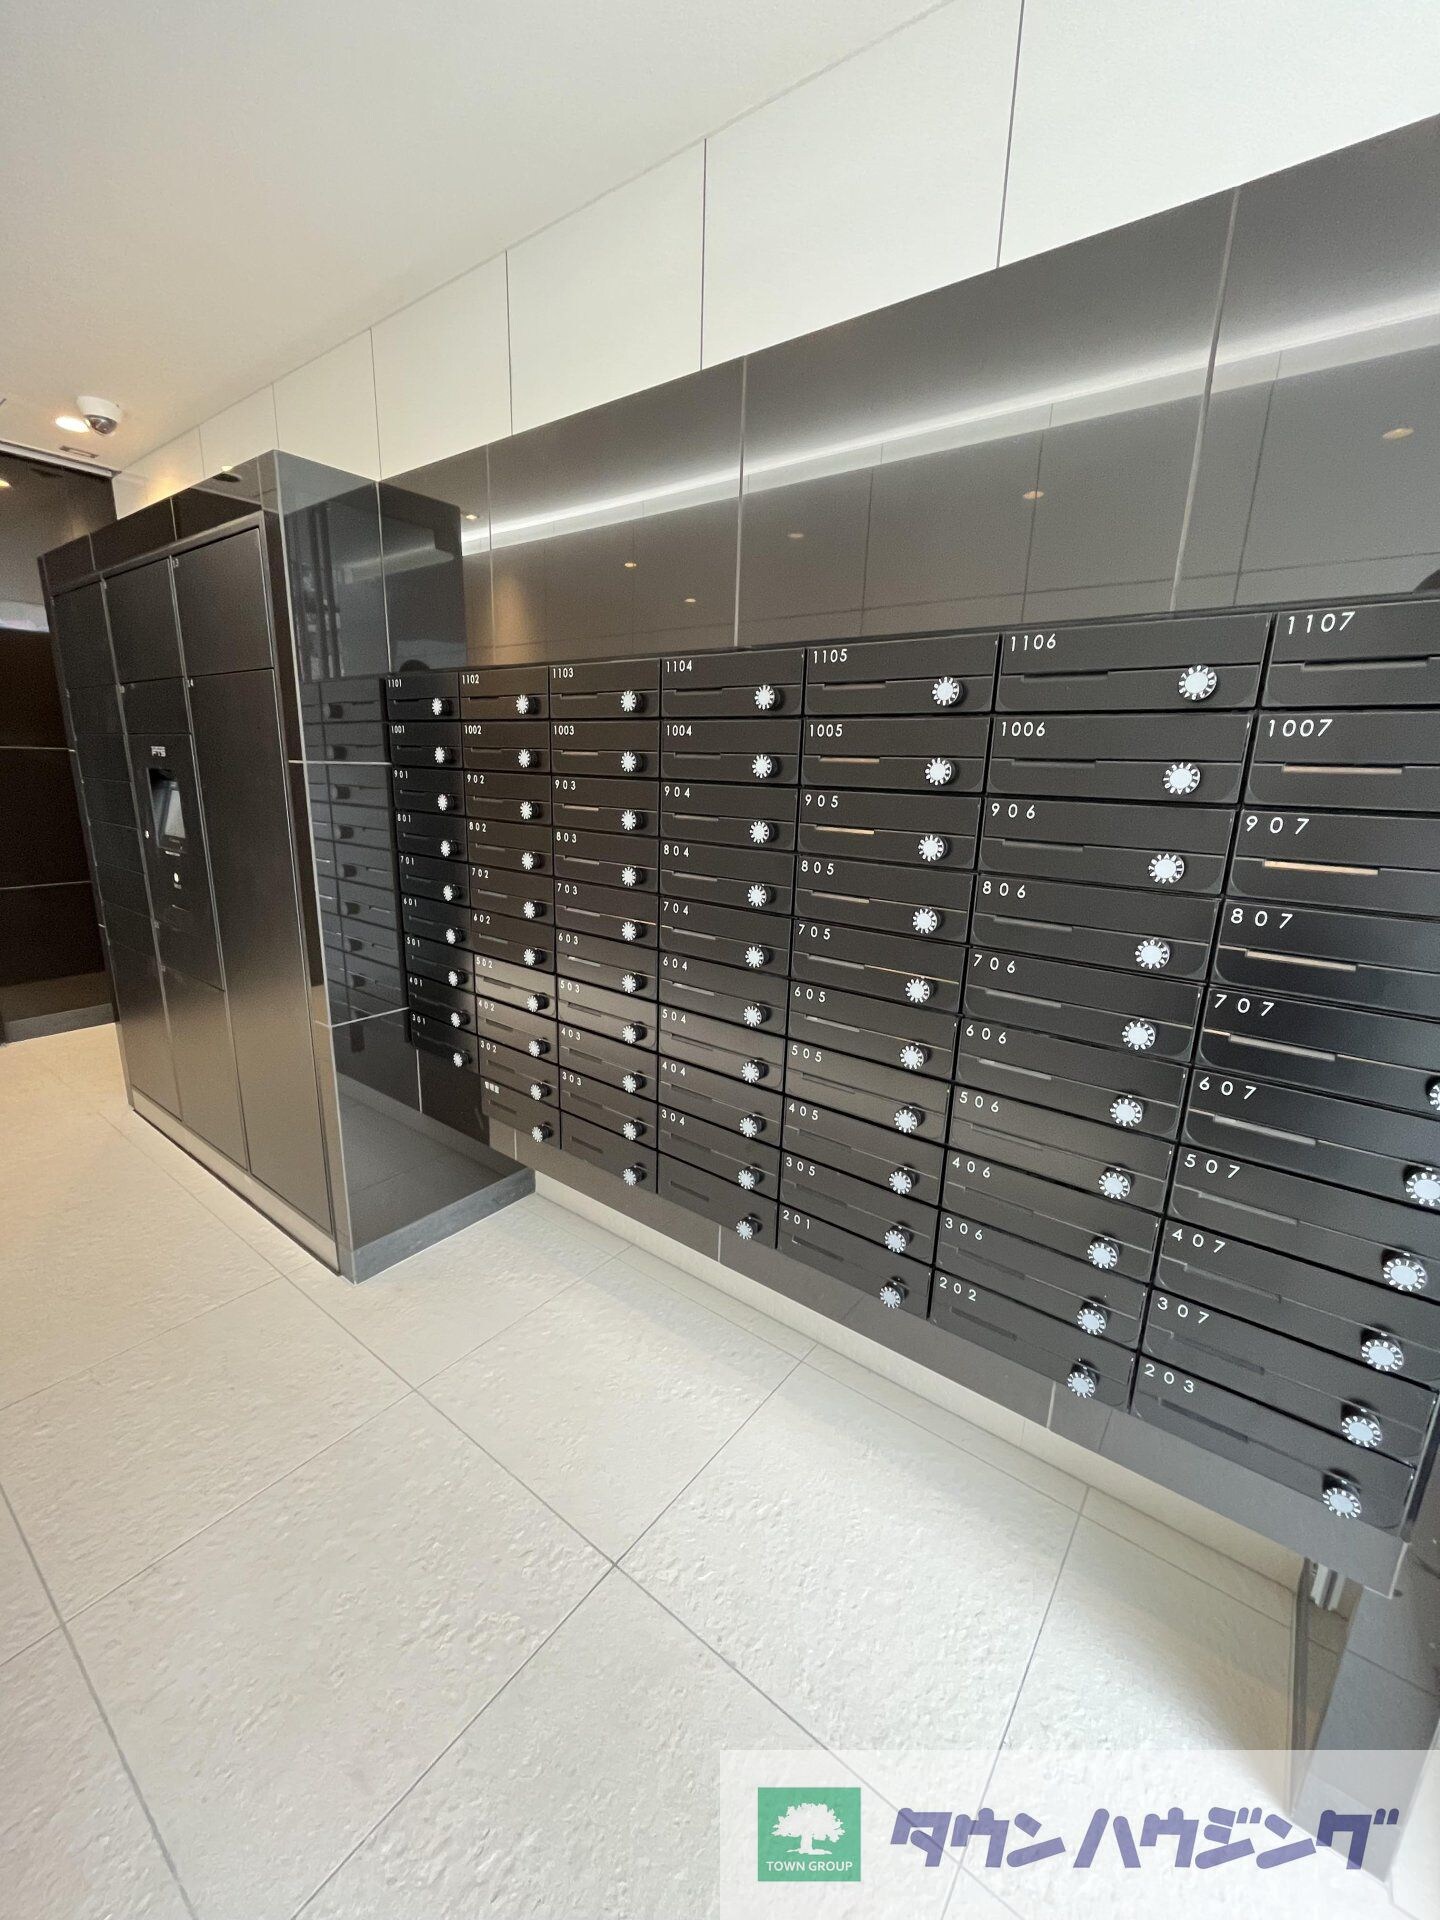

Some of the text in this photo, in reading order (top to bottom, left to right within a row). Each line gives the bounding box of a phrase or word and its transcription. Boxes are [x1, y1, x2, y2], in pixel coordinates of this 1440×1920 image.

[1289, 611, 1355, 634] 1107
[1012, 634, 1055, 651] 1106
[814, 649, 847, 663] 1105
[553, 668, 573, 678] 1103
[667, 660, 692, 672] 1104
[463, 674, 479, 684] 1102
[465, 725, 481, 734] 1002
[554, 725, 574, 735] 1003
[667, 725, 691, 736] 1004
[810, 724, 842, 737] 1005
[1003, 722, 1045, 736] 1006
[1270, 719, 1332, 737] 1007
[467, 774, 484, 784] 902
[555, 780, 575, 790] 903
[665, 786, 690, 798] 904
[806, 794, 838, 807] 905
[992, 803, 1035, 819] 906
[469, 822, 486, 832] 802
[1247, 816, 1309, 834] 907
[557, 832, 576, 843] 803
[664, 844, 689, 857] 804
[472, 868, 488, 878] 702
[802, 860, 833, 875] 805
[558, 883, 577, 895] 703
[983, 881, 1025, 898] 806
[664, 902, 688, 915] 704
[474, 914, 490, 924] 602
[1231, 908, 1293, 928] 807
[559, 933, 578, 944] 603
[799, 924, 830, 940] 705
[476, 957, 492, 968] 502
[663, 957, 687, 970] 604
[974, 954, 1015, 973] 706
[561, 980, 579, 993] 503
[795, 987, 825, 1002] 605
[479, 1000, 494, 1011] 402
[1215, 994, 1274, 1016] 707
[662, 1009, 686, 1023] 504
[562, 1028, 580, 1040] 403
[967, 1025, 1006, 1044] 606
[481, 1041, 496, 1053] 302
[792, 1045, 821, 1062] 505
[662, 1062, 685, 1076] 404
[563, 1072, 581, 1085] 303
[1200, 1077, 1256, 1099] 607
[960, 1092, 998, 1112] 506
[662, 1109, 684, 1125] 304
[789, 1103, 818, 1120] 405
[786, 1157, 815, 1176] 305
[953, 1157, 990, 1178] 406
[1185, 1154, 1240, 1178] 507
[783, 1210, 809, 1229] 201
[945, 1218, 982, 1240] 306
[1172, 1229, 1225, 1252] 407
[940, 1277, 976, 1301] 202
[1158, 1297, 1209, 1323] 307
[1144, 1364, 1194, 1393] 203
